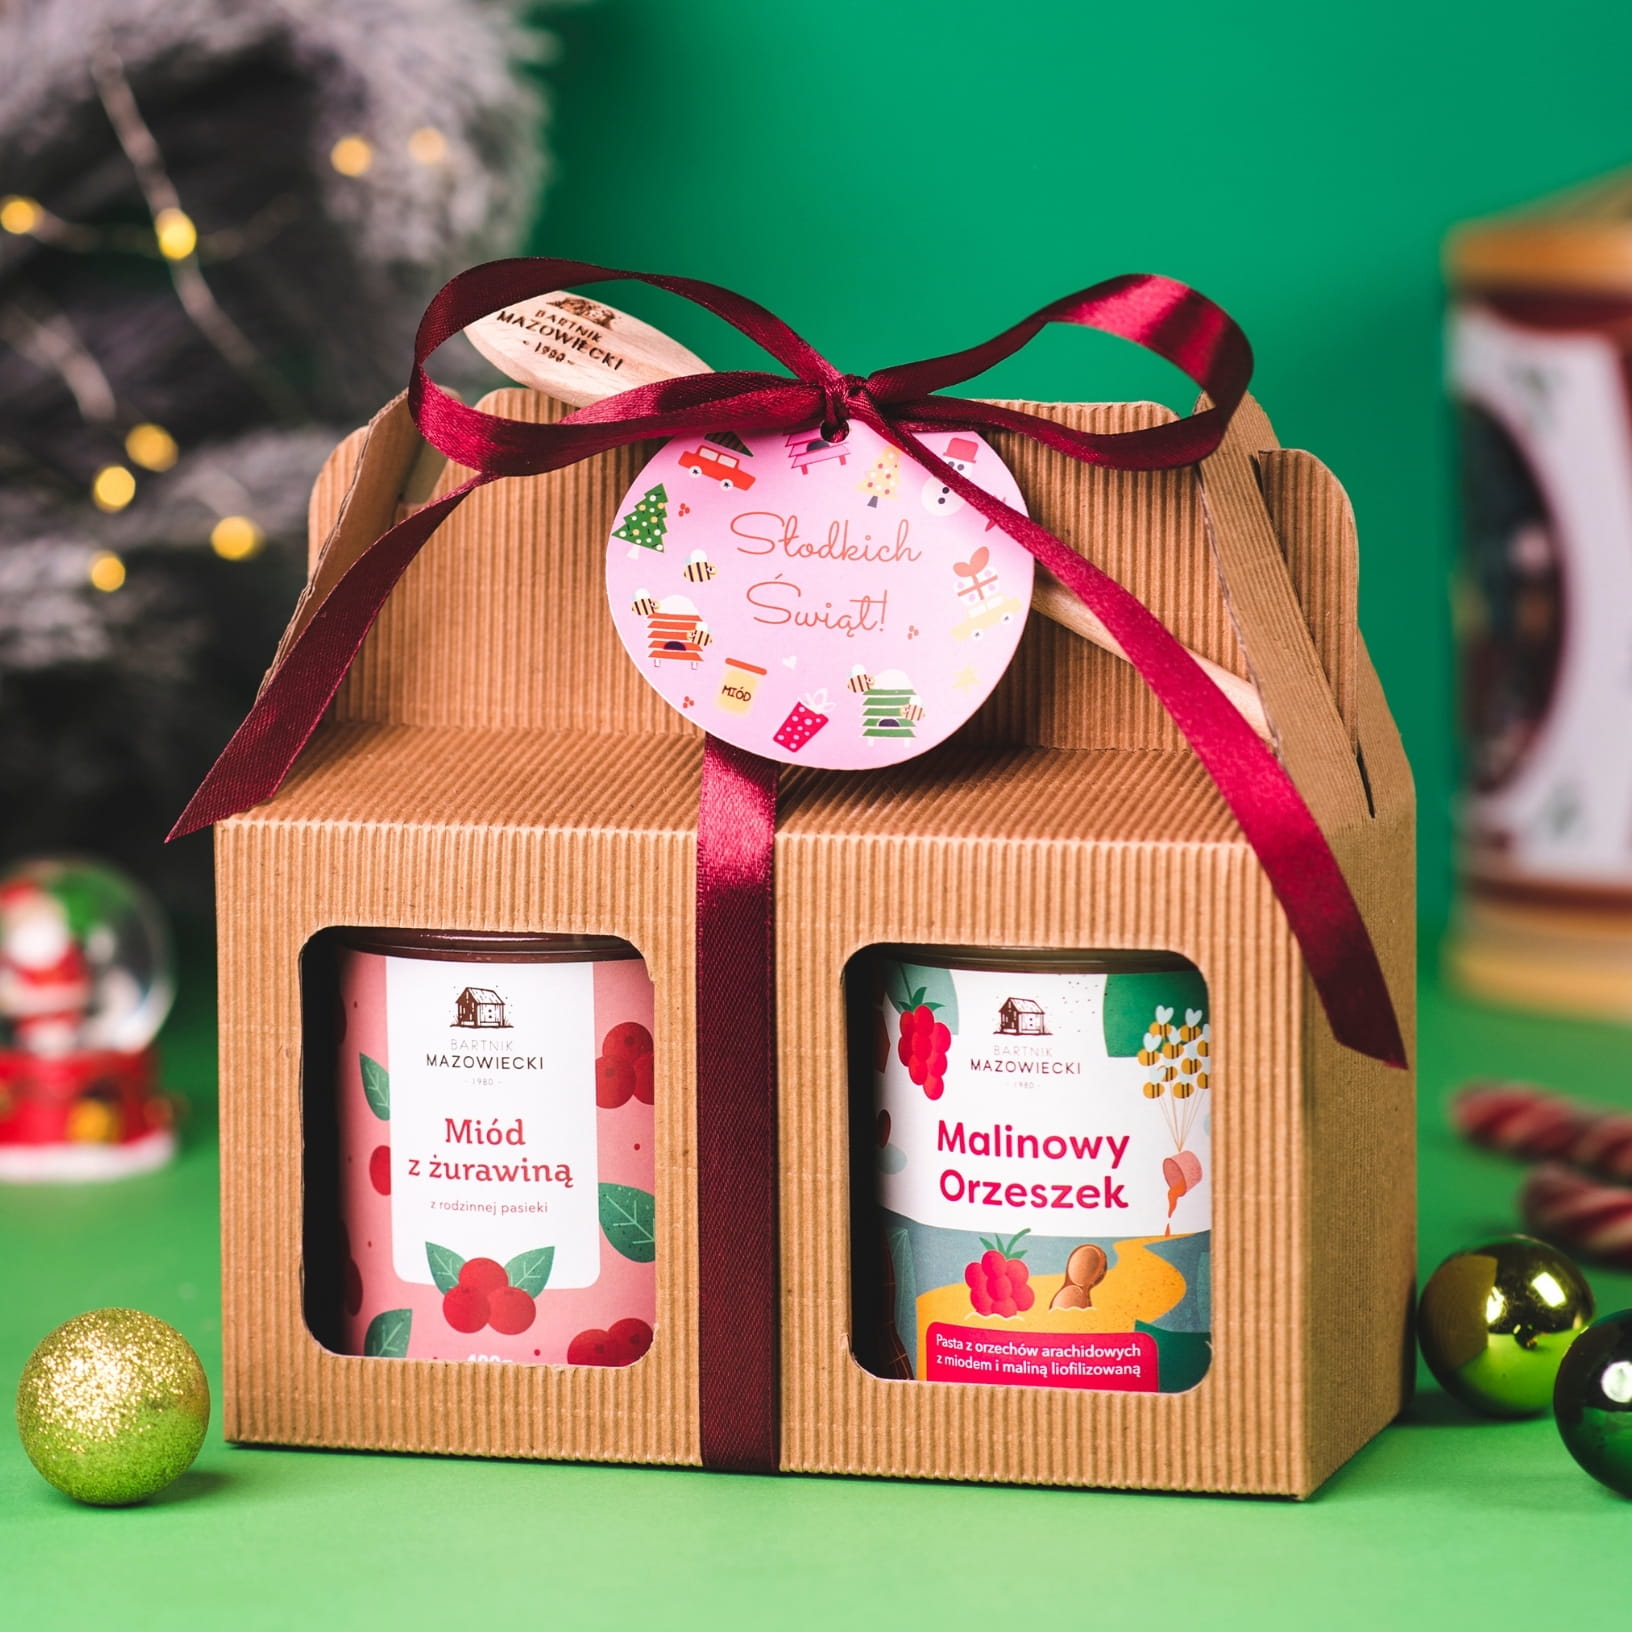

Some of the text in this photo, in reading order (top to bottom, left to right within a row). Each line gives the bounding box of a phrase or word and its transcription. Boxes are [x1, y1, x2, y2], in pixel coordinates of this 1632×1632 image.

[535, 309, 602, 342] BARTNIK
[497, 311, 623, 370] MAZOWIECKI
[730, 511, 922, 562] Słodkich
[746, 573, 888, 638] Świąt!
[721, 685, 752, 702] MIÓD
[450, 1039, 513, 1051] BARTNIK
[993, 1045, 1053, 1057] BARTNIK
[426, 1053, 544, 1070] MAZOWIECKI
[970, 1058, 1081, 1075] MAZOWIECKI
[444, 1118, 526, 1146] Miód
[937, 1120, 1130, 1169] Malinowy
[408, 1154, 574, 1188] z żurawiną
[940, 1168, 1129, 1209] Orzeszek
[430, 1200, 548, 1216] z rodzinnej pasieki
[935, 1333, 1141, 1361] Pasta z orzechów arachidowych
[936, 1354, 943, 1365] z
[944, 1356, 992, 1371] miodem
[1002, 1360, 1048, 1378] maliną
[1051, 1361, 1141, 1378] liofilizowaną
